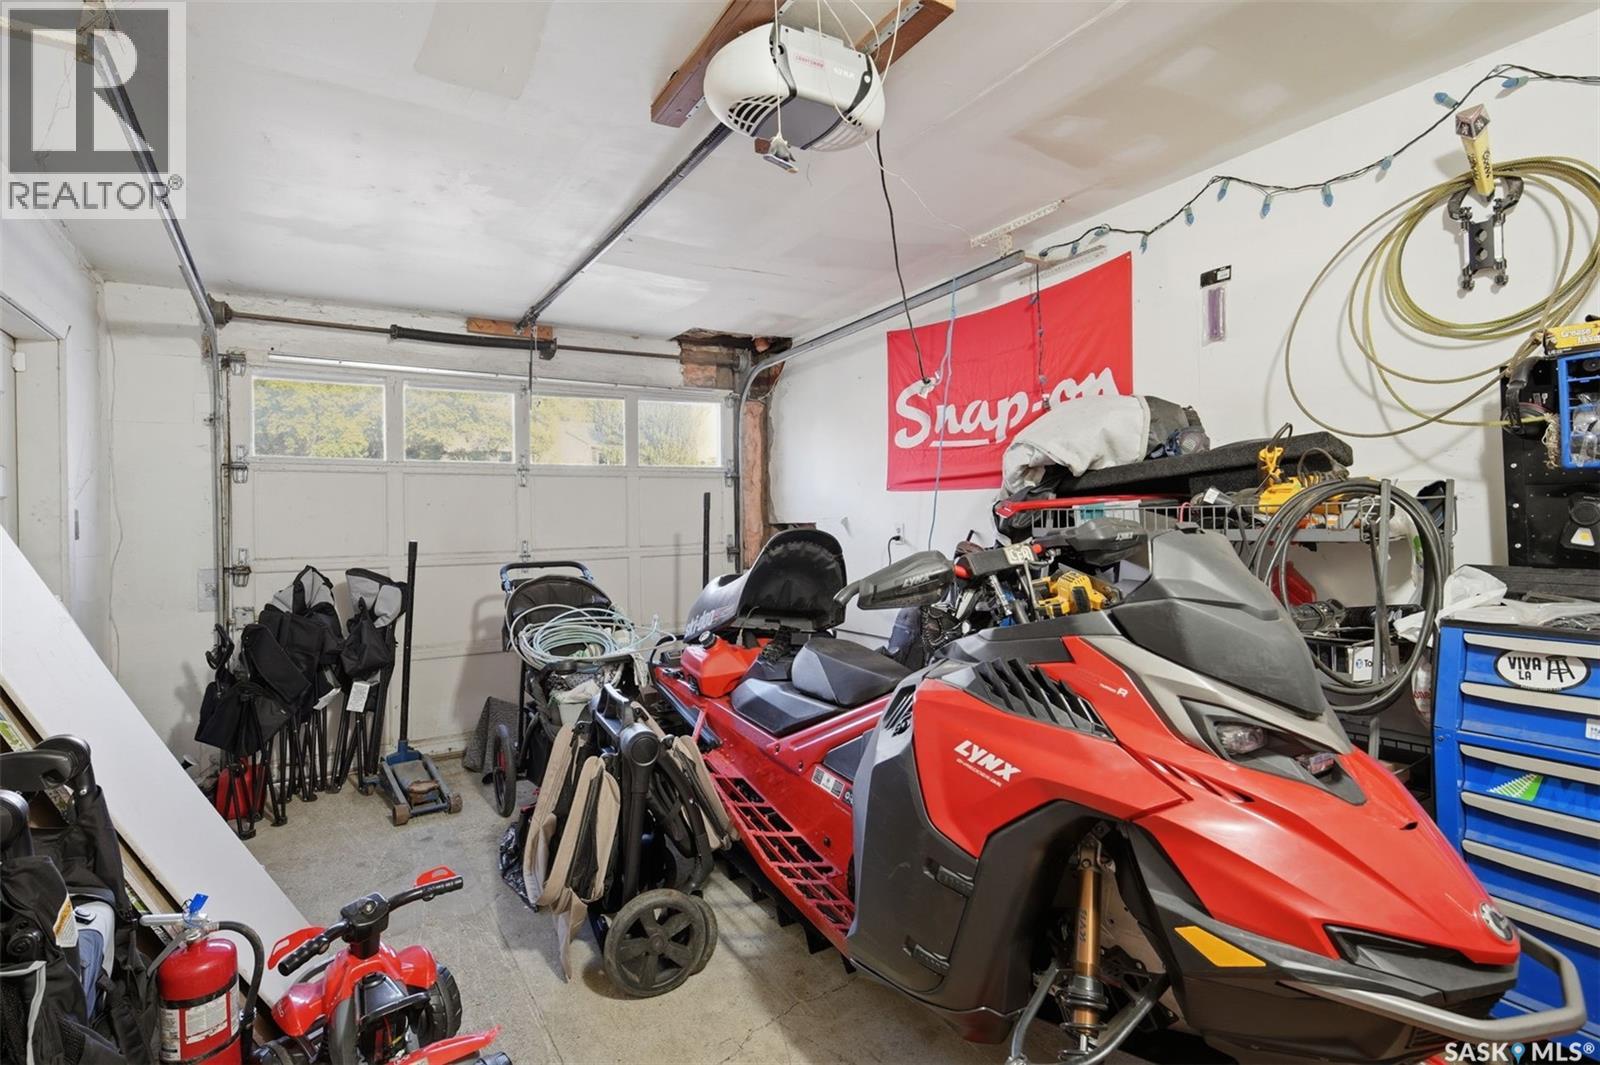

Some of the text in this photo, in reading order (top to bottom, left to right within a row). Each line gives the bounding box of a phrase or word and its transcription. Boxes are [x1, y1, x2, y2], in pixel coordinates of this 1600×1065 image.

[1508, 656, 1541, 670] VIVA
[1518, 670, 1533, 681] LA
[953, 739, 1022, 782] LYNX
